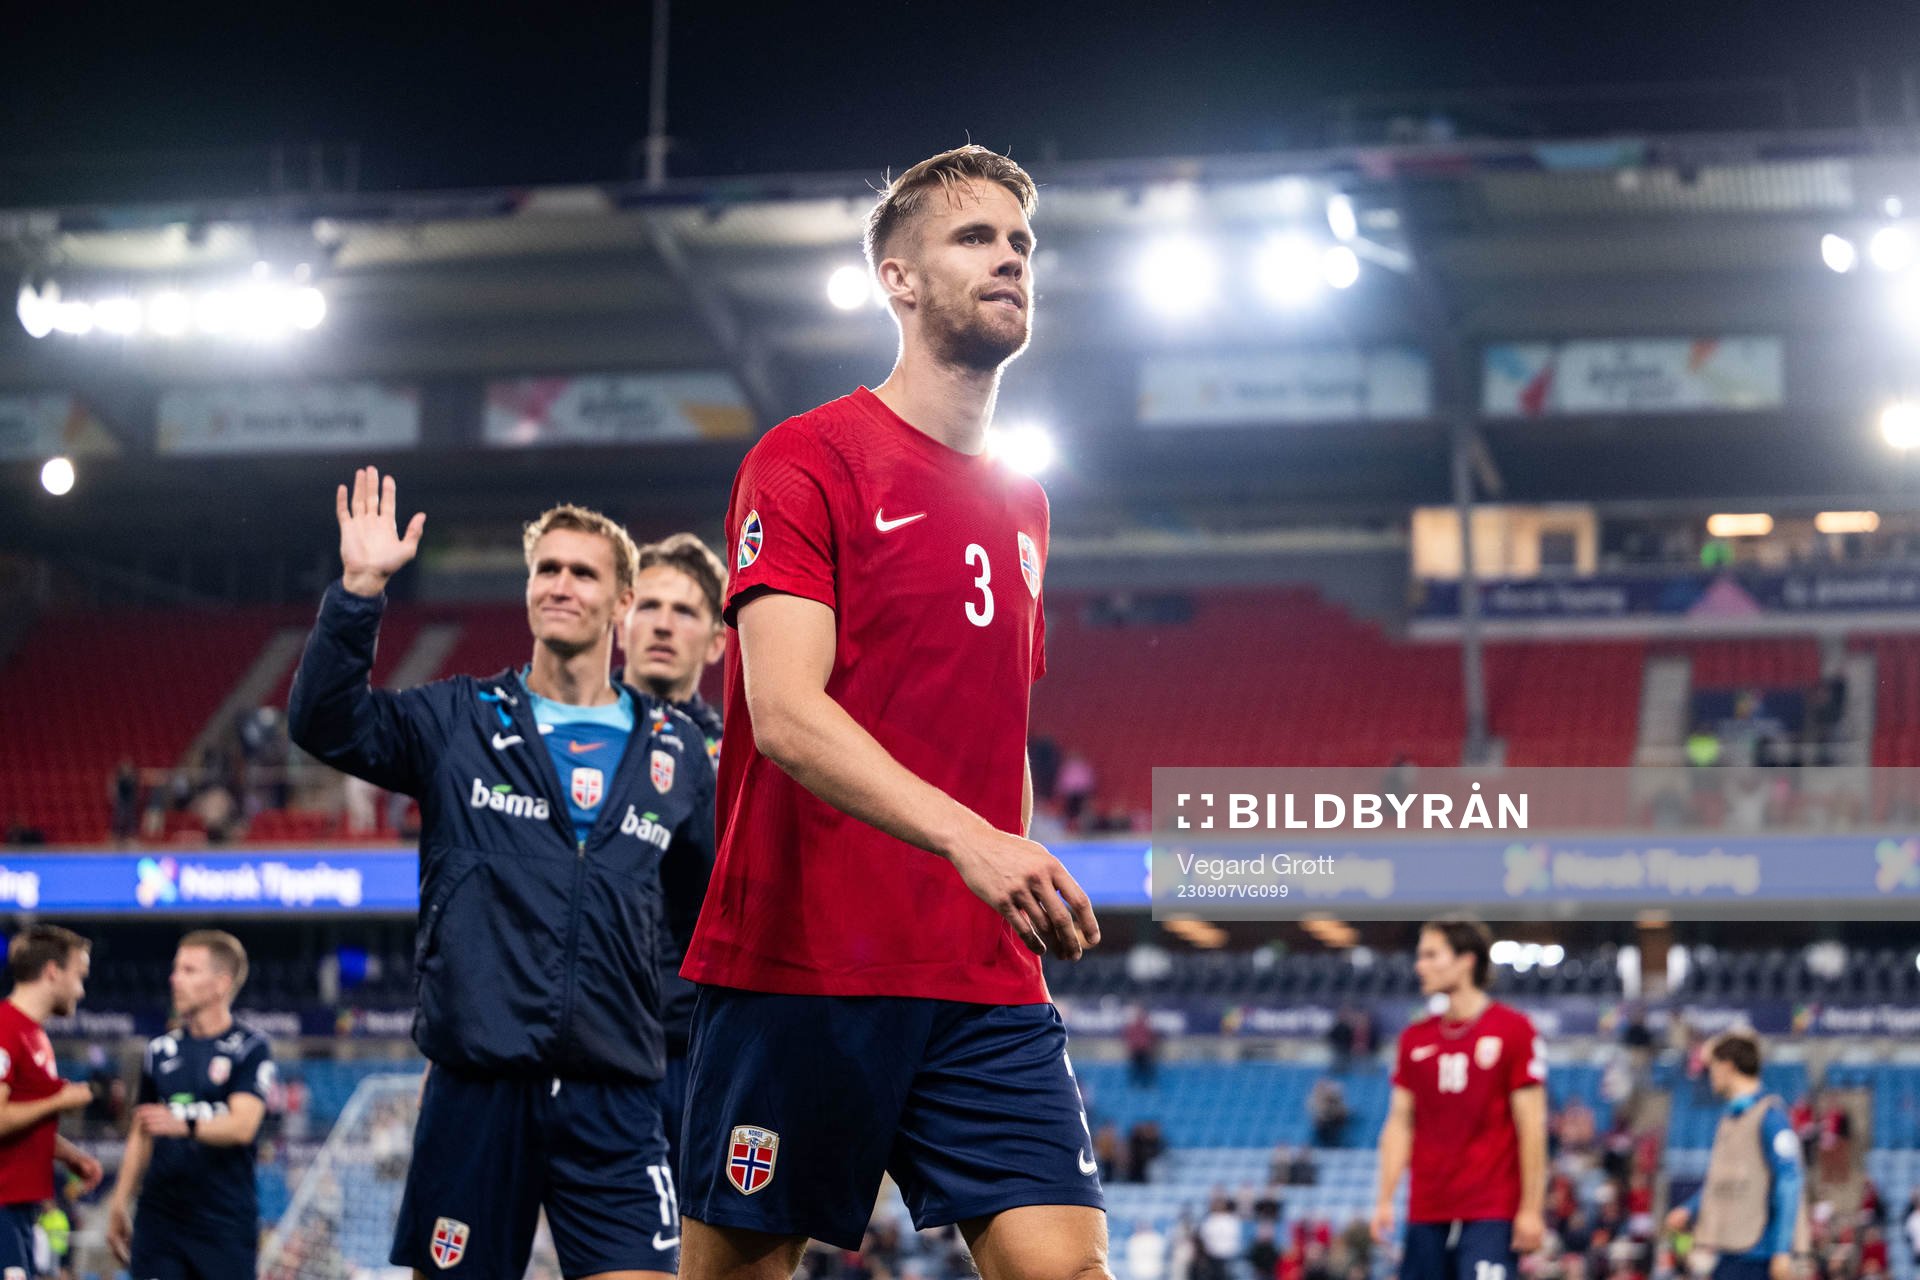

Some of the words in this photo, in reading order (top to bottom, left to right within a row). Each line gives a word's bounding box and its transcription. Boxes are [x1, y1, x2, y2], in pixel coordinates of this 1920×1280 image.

[964, 543, 995, 628] 3
[471, 778, 550, 820] bama
[646, 1165, 680, 1227] 11
